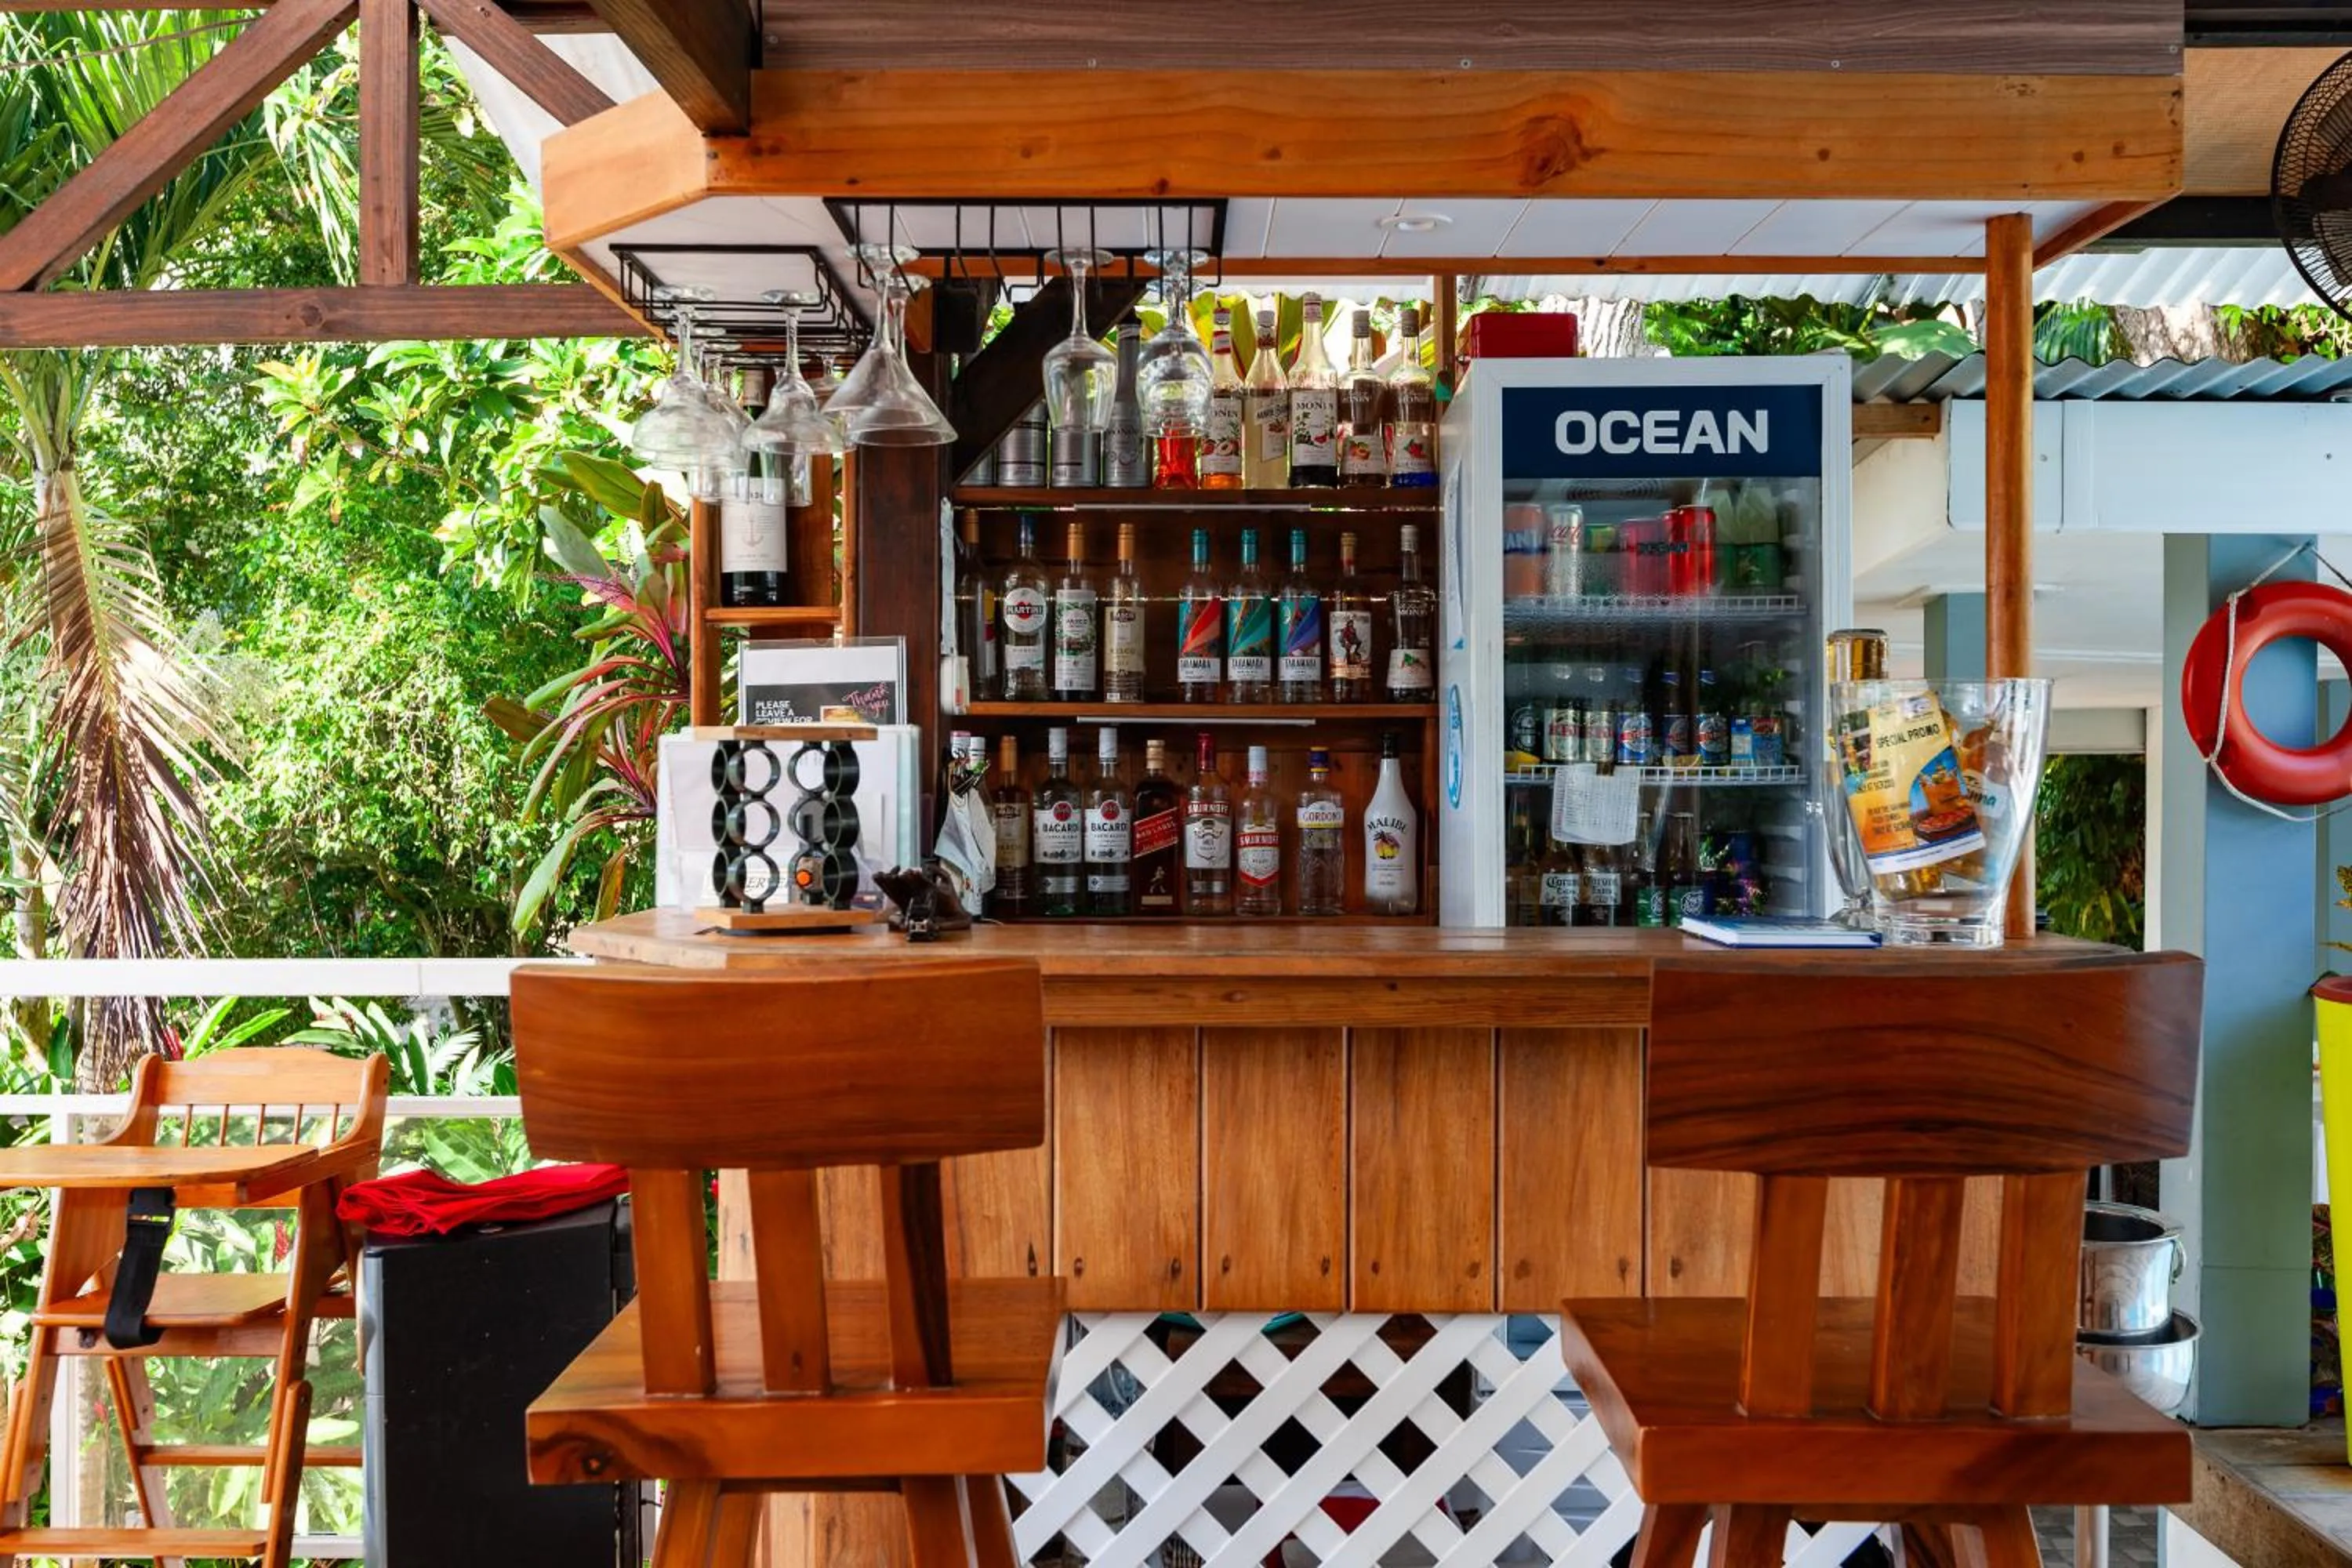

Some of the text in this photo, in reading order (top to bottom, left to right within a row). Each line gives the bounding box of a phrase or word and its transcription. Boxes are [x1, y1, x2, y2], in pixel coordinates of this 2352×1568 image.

[1555, 409, 1769, 455] OCEAN
[1006, 604, 1044, 615] MARTINI
[755, 700, 790, 709] PLEASE
[1876, 724, 1940, 748] SPECIAL PROMO
[1188, 804, 1229, 814] SMIRNOFF
[1239, 835, 1279, 846] SMIRNOFF
